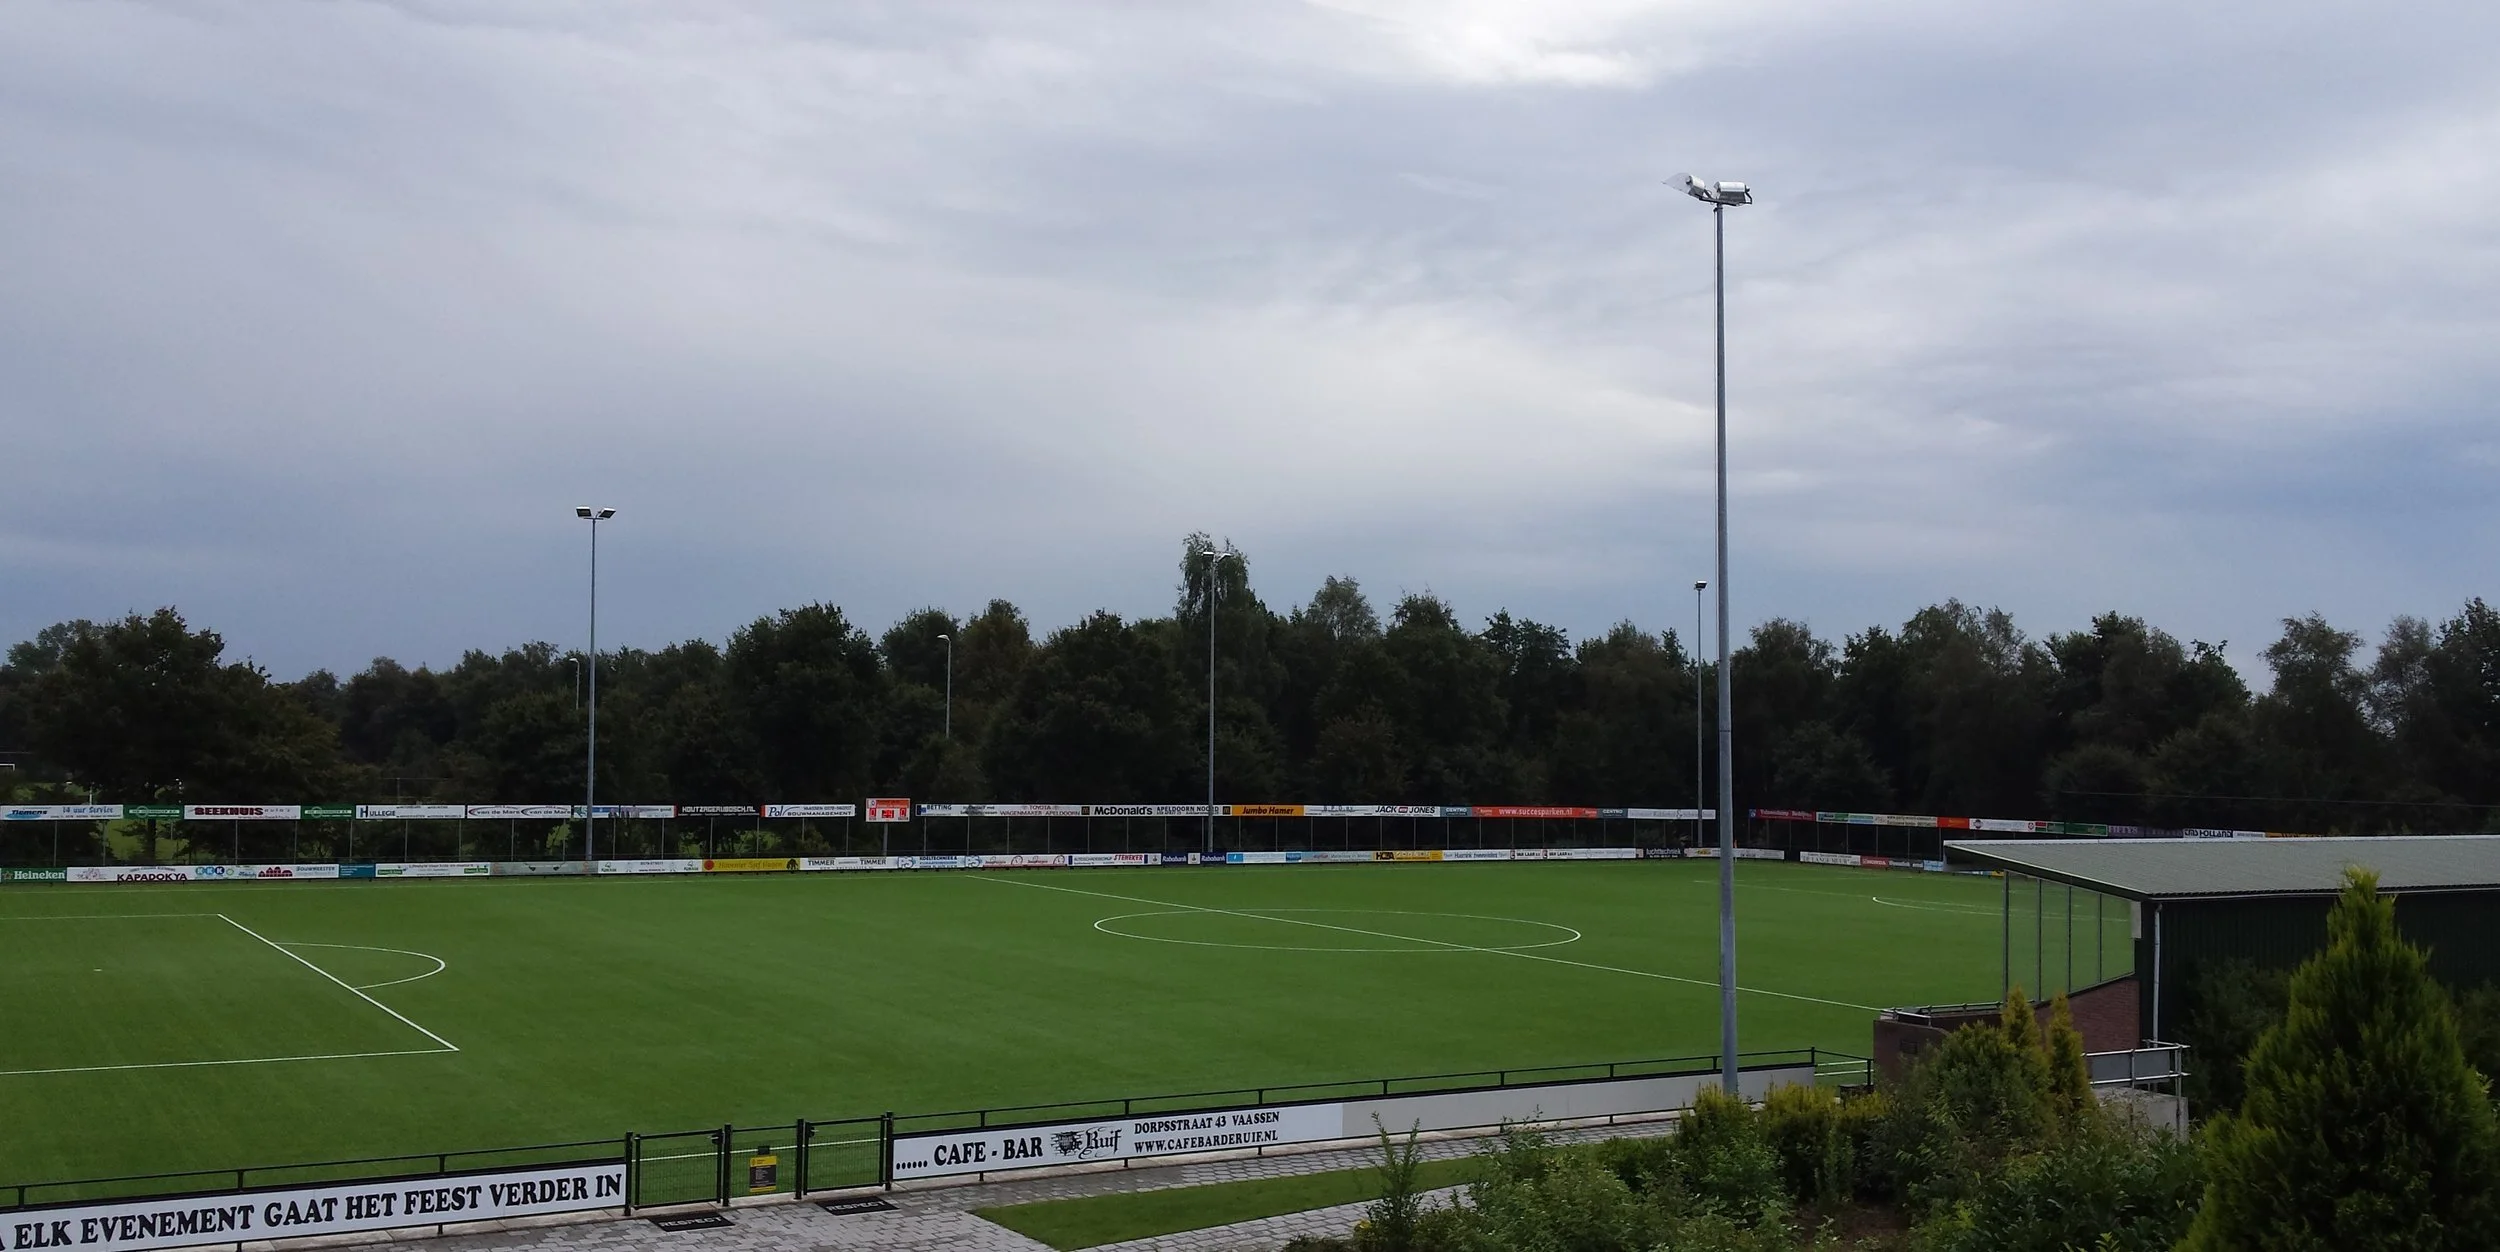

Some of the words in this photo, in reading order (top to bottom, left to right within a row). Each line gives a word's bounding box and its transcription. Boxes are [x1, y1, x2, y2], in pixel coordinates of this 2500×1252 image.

[194, 807, 264, 816] BEEKHUIS
[769, 806, 783, 817] Pol
[1094, 806, 1153, 815] McDonald's
[1243, 807, 1268, 815] Jumbo
[1270, 807, 1295, 815] Hamer
[1409, 806, 1436, 814] JONES
[1498, 808, 1573, 817] www.succesparken.nl
[14, 871, 65, 880] Heineken
[117, 873, 187, 882] KAPADOKYA
[1135, 1117, 1213, 1134] DORPSSTRAAT
[1215, 1116, 1227, 1128] 43
[1232, 1112, 1280, 1127] VAASSEN
[1134, 1130, 1279, 1154] WWW.CAFEBARDERUIF.NL
[934, 1142, 986, 1166] CAFE
[1003, 1136, 1044, 1160] BAR
[825, 1200, 885, 1211] RESPECT
[14, 1221, 72, 1249] ELK
[81, 1205, 254, 1244] EVENEMENT
[264, 1197, 338, 1228] GAAT
[345, 1192, 397, 1220] HET
[403, 1185, 481, 1215] FEEST
[490, 1177, 588, 1208] VERDER
[595, 1173, 622, 1198] IN
[658, 1216, 723, 1227] RESPECT
